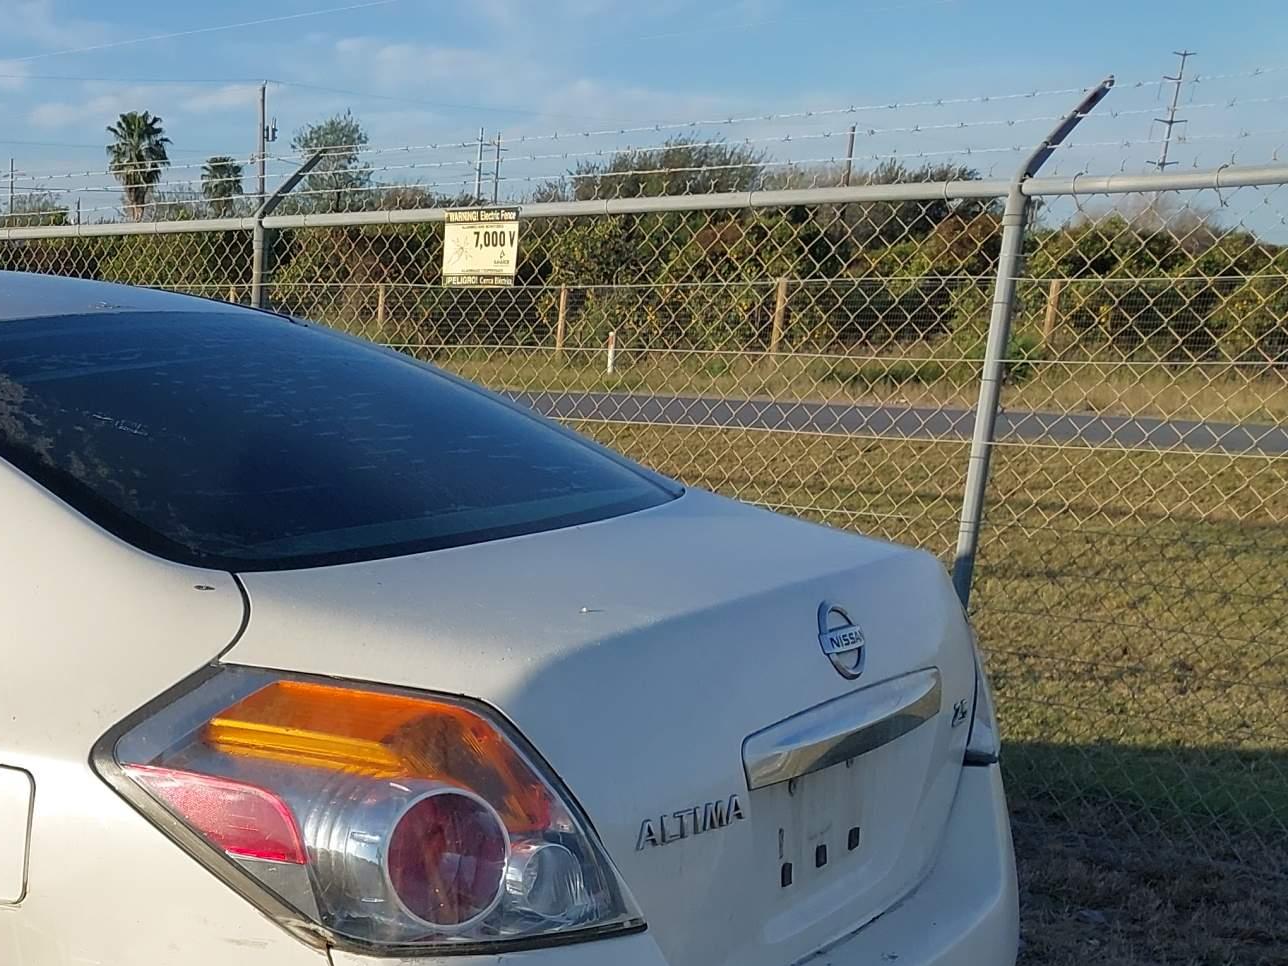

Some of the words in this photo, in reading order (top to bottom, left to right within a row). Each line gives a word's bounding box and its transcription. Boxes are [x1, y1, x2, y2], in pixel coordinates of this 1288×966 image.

[449, 210, 479, 222] WARNING!
[480, 209, 500, 220] Electric
[501, 208, 516, 220] Fence
[473, 230, 506, 250] 7,000
[508, 230, 516, 248] V
[635, 793, 746, 852] ALTIMA
